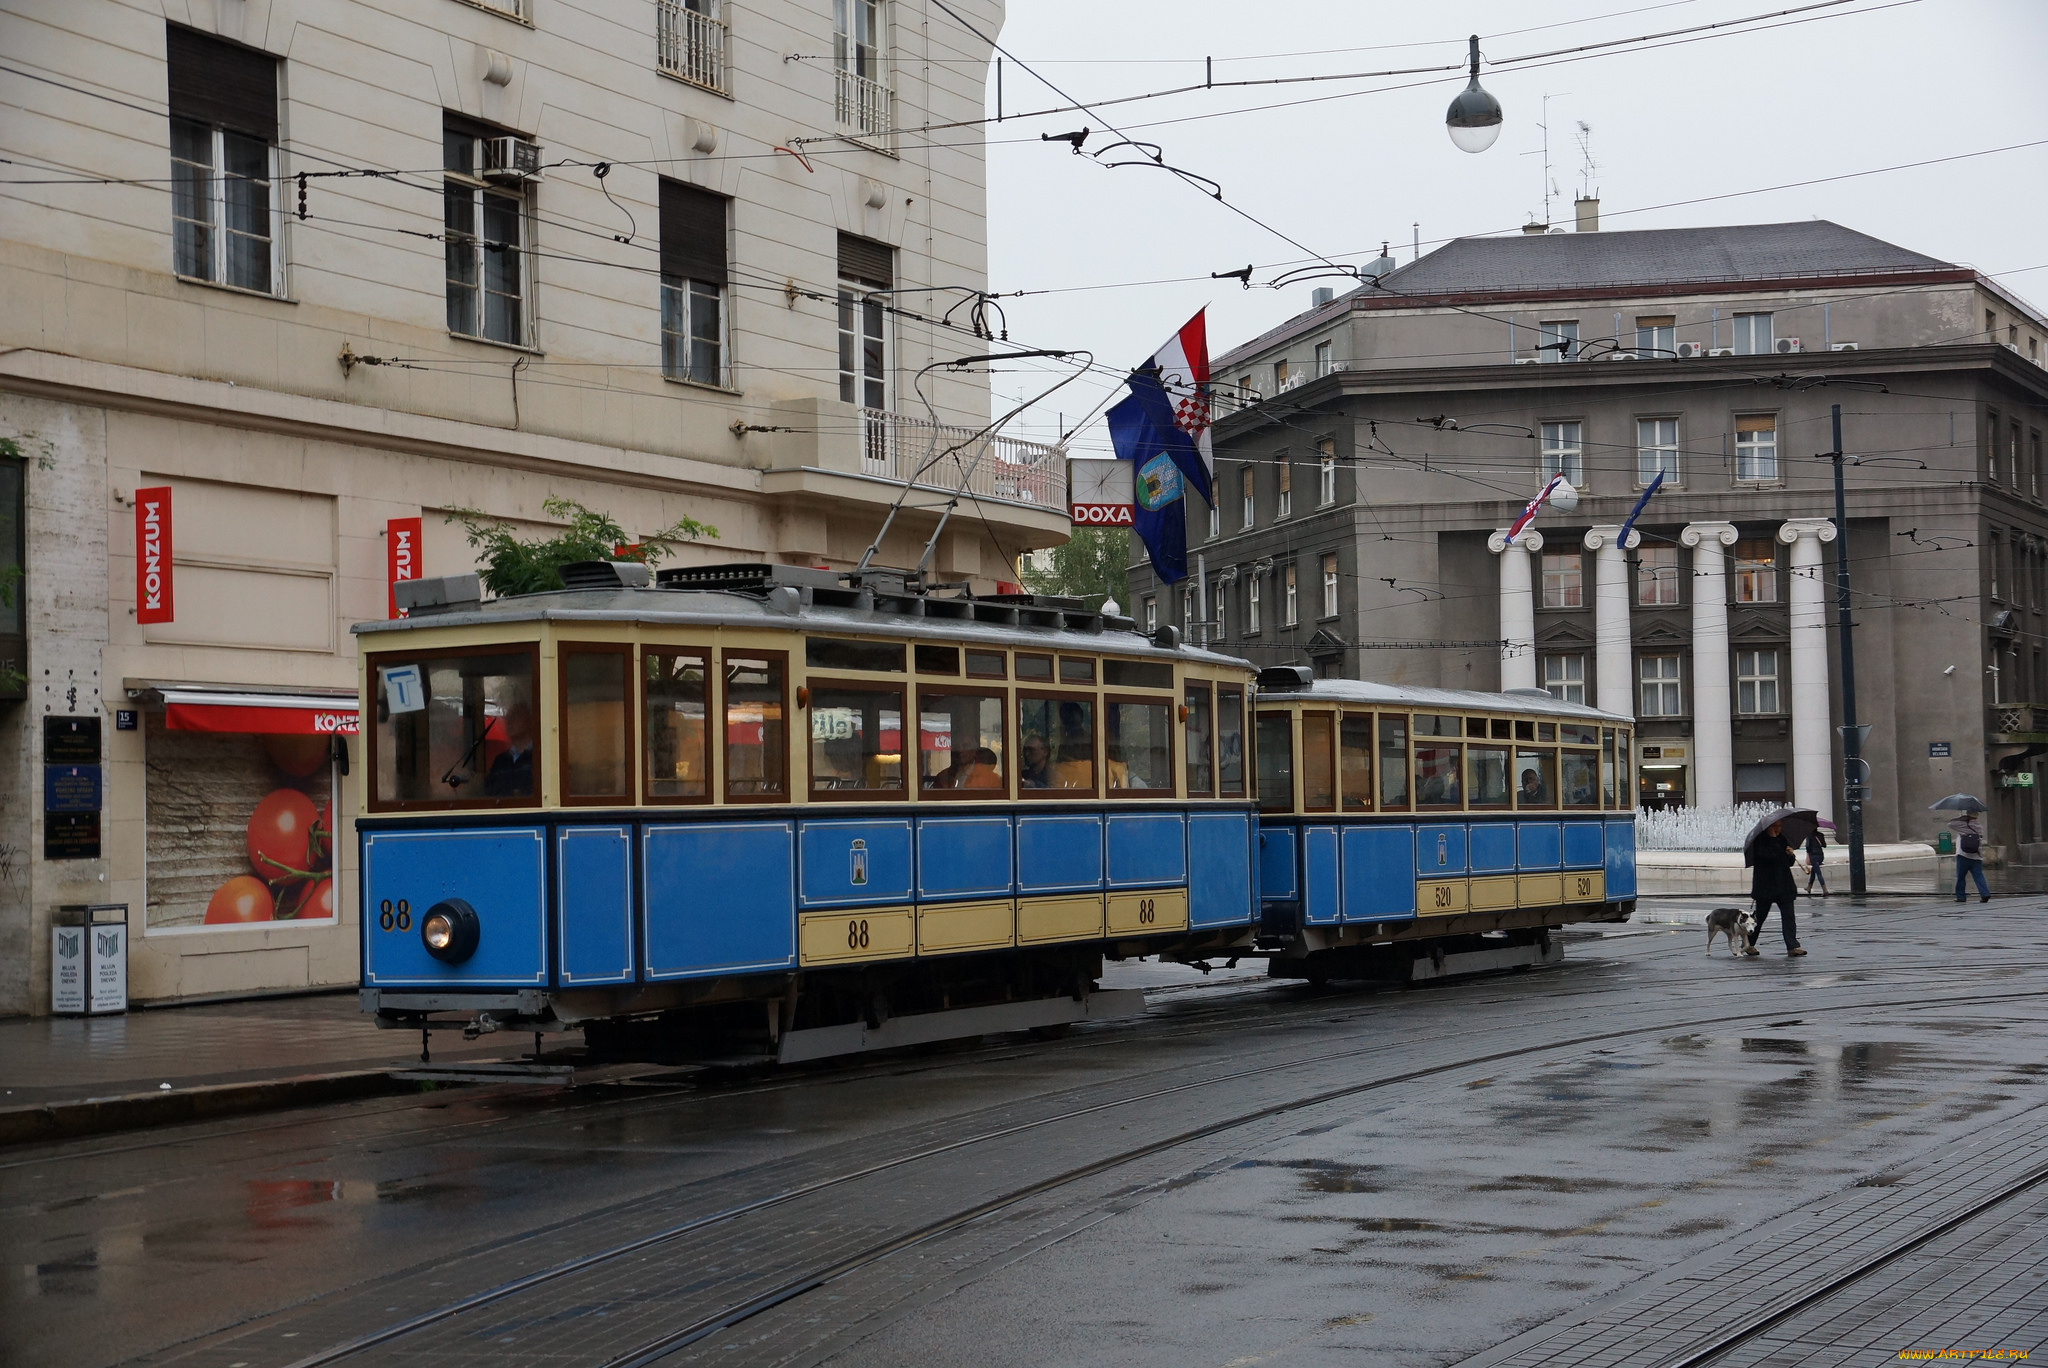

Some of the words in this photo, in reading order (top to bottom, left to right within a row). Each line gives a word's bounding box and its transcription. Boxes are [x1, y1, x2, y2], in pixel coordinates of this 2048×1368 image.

[1074, 506, 1132, 522] DOXA
[145, 501, 161, 610] KONZUM
[387, 670, 416, 707] T
[120, 711, 129, 721] 15
[314, 714, 360, 731] KONZ
[1435, 887, 1451, 907] 520
[1577, 878, 1590, 896] 520
[380, 899, 413, 932] 88
[1140, 898, 1154, 924] 88
[848, 919, 869, 949] 88
